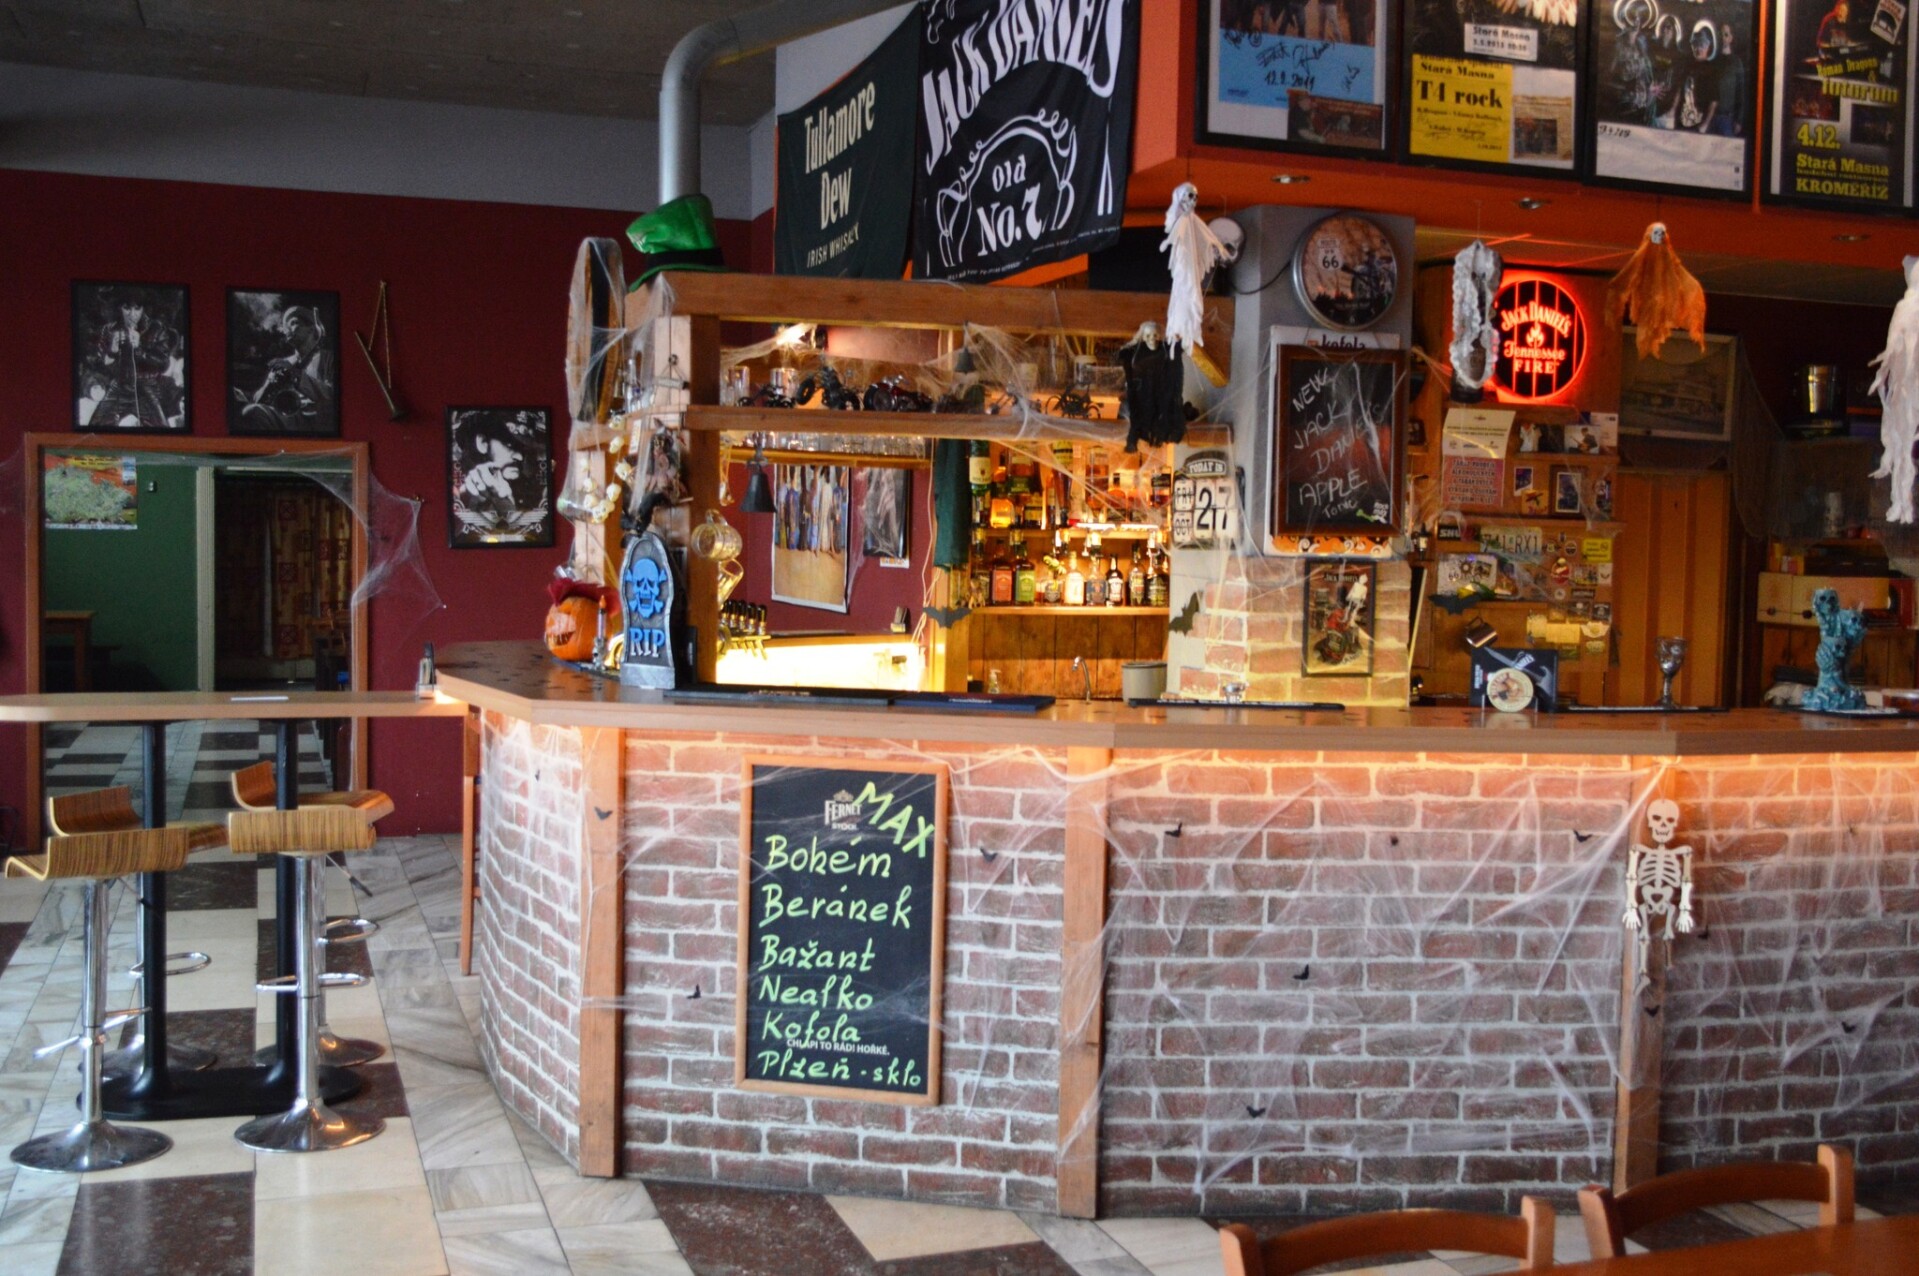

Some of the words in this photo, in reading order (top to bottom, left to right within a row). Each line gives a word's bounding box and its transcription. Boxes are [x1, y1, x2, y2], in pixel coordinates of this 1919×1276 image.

[1421, 61, 1452, 75] Stará
[1457, 66, 1494, 79] Masna
[923, 10, 990, 175] JACK
[1455, 88, 1502, 109] rock
[805, 82, 875, 174] Tullamore
[1797, 122, 1841, 149] 4.12.
[1796, 153, 1837, 171] Stará
[1841, 158, 1889, 177] Masna
[821, 168, 853, 230] Dew
[807, 246, 828, 269] IRISH
[829, 222, 860, 258] WHISKEY
[1322, 255, 1339, 269] 66
[1501, 306, 1528, 332] JACK
[1529, 300, 1571, 338] DANIEL'S
[1503, 340, 1566, 361] Tennessee
[1514, 359, 1555, 374] FIRE
[1293, 367, 1328, 412] NEW
[1294, 400, 1349, 449] JACK
[1176, 486, 1191, 504] FRI
[1299, 468, 1367, 506] APPLE
[1175, 518, 1190, 536] OCT
[629, 627, 666, 658] RIP
[825, 800, 862, 826] FERNET
[851, 781, 935, 858] MAX
[764, 834, 892, 878] Bohém
[758, 883, 912, 929] Beránek
[758, 934, 876, 972] Bažant
[758, 974, 873, 1010] Nealko
[761, 1010, 862, 1048] Kofola
[786, 1038, 818, 1050] CHLAPI
[820, 1040, 832, 1051] TO
[758, 1048, 851, 1080] Plzeň
[873, 1057, 921, 1087] sklo
